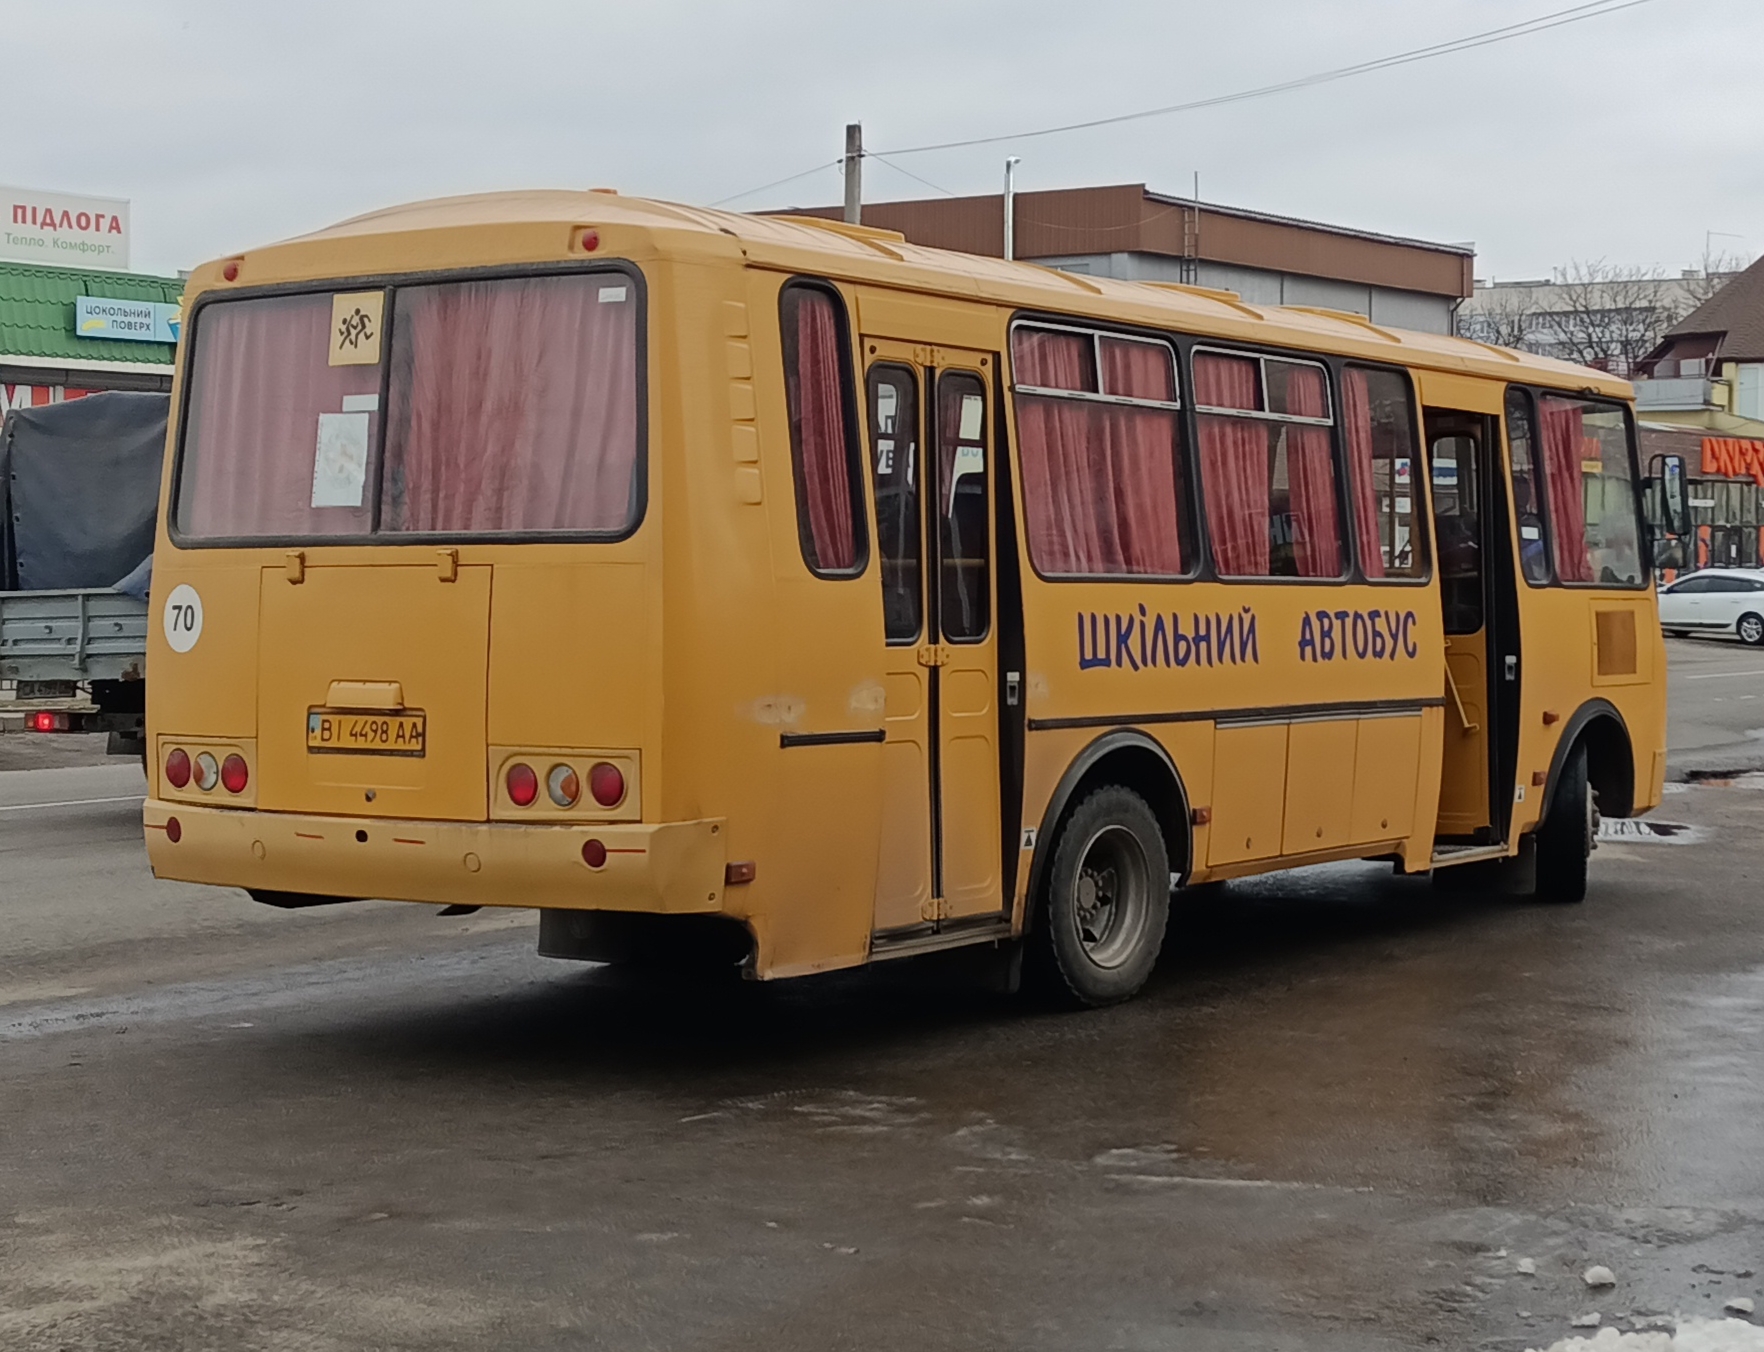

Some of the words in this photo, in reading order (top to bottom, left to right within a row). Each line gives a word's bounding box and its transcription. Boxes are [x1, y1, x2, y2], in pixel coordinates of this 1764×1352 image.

[12, 203, 122, 235] ПІДЛОГА
[4, 232, 48, 248] Тепло.
[52, 236, 115, 256] Комфорт.
[85, 304, 152, 319] ЦОКОЛЬНИЙ
[111, 319, 152, 332] ПОВЕРХ
[171, 604, 195, 632] 70
[1298, 609, 1417, 663] АВТОБУС
[349, 719, 389, 744] 4498
[394, 720, 420, 746] AA
